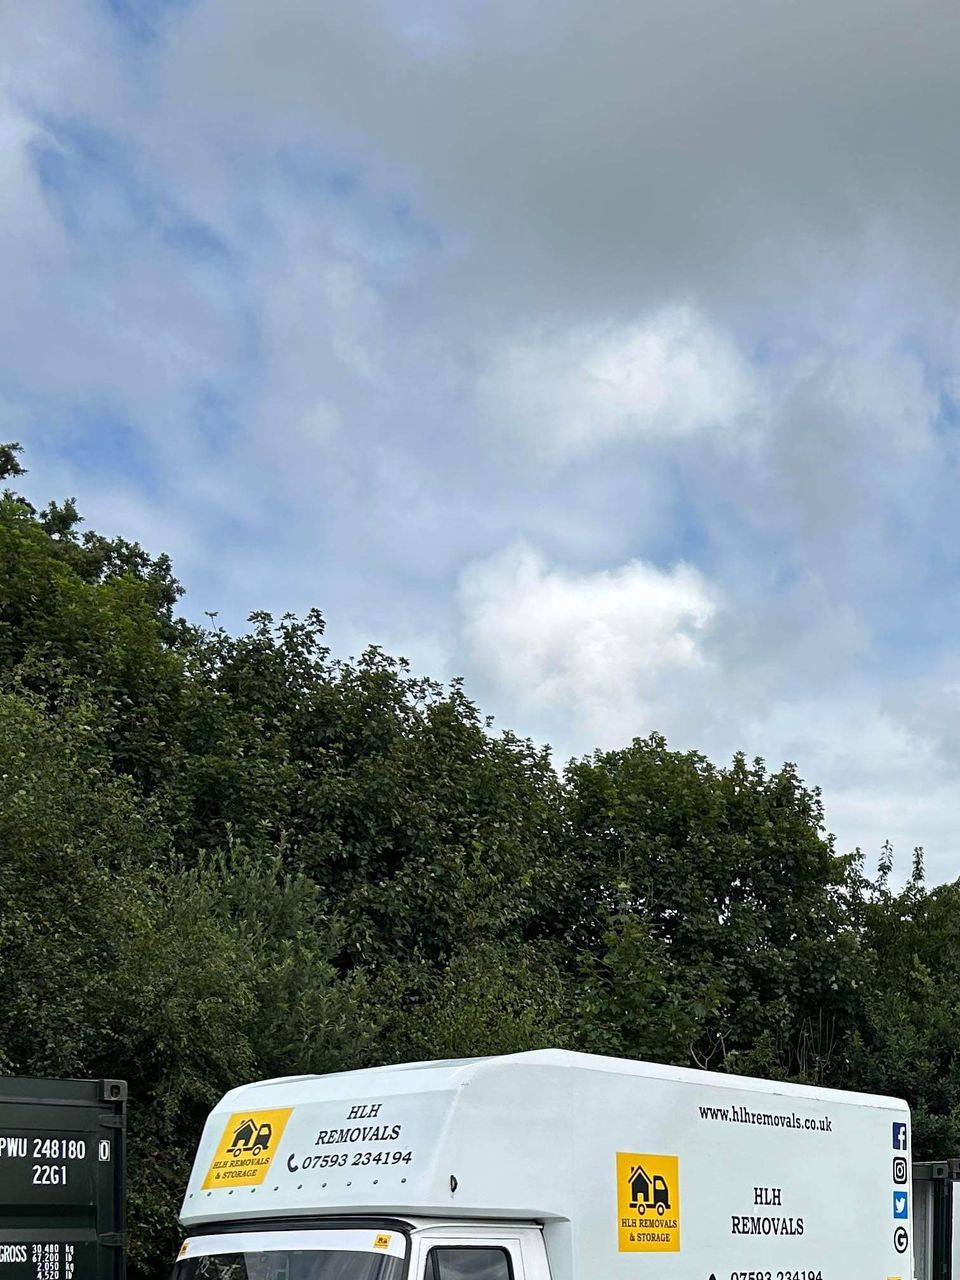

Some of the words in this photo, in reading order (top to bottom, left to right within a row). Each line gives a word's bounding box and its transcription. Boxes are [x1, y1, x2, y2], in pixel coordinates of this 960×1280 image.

[346, 1103, 382, 1120] HLH
[699, 1105, 832, 1132] www.hlhremovals.co.uk
[315, 1125, 401, 1146] REMOVALS
[33, 1138, 86, 1159] 248180
[213, 1161, 229, 1170] HLH
[229, 1157, 270, 1168] REMOVALS
[302, 1153, 349, 1169] 07593
[351, 1151, 412, 1167] 234194
[32, 1164, 67, 1185] 22G1
[222, 1169, 258, 1179] STORAGE
[754, 1187, 782, 1206] HLH
[621, 1218, 637, 1228] HLH
[639, 1219, 678, 1229] REMOVALS
[731, 1216, 804, 1236] REMOVALS
[629, 1232, 635, 1242] &
[637, 1232, 671, 1242] STORAGE
[65, 1244, 74, 1255] kg
[32, 1253, 60, 1263] 67.200
[37, 1262, 60, 1272] 2.050
[65, 1262, 75, 1273] kg
[36, 1271, 60, 1280] 4.520
